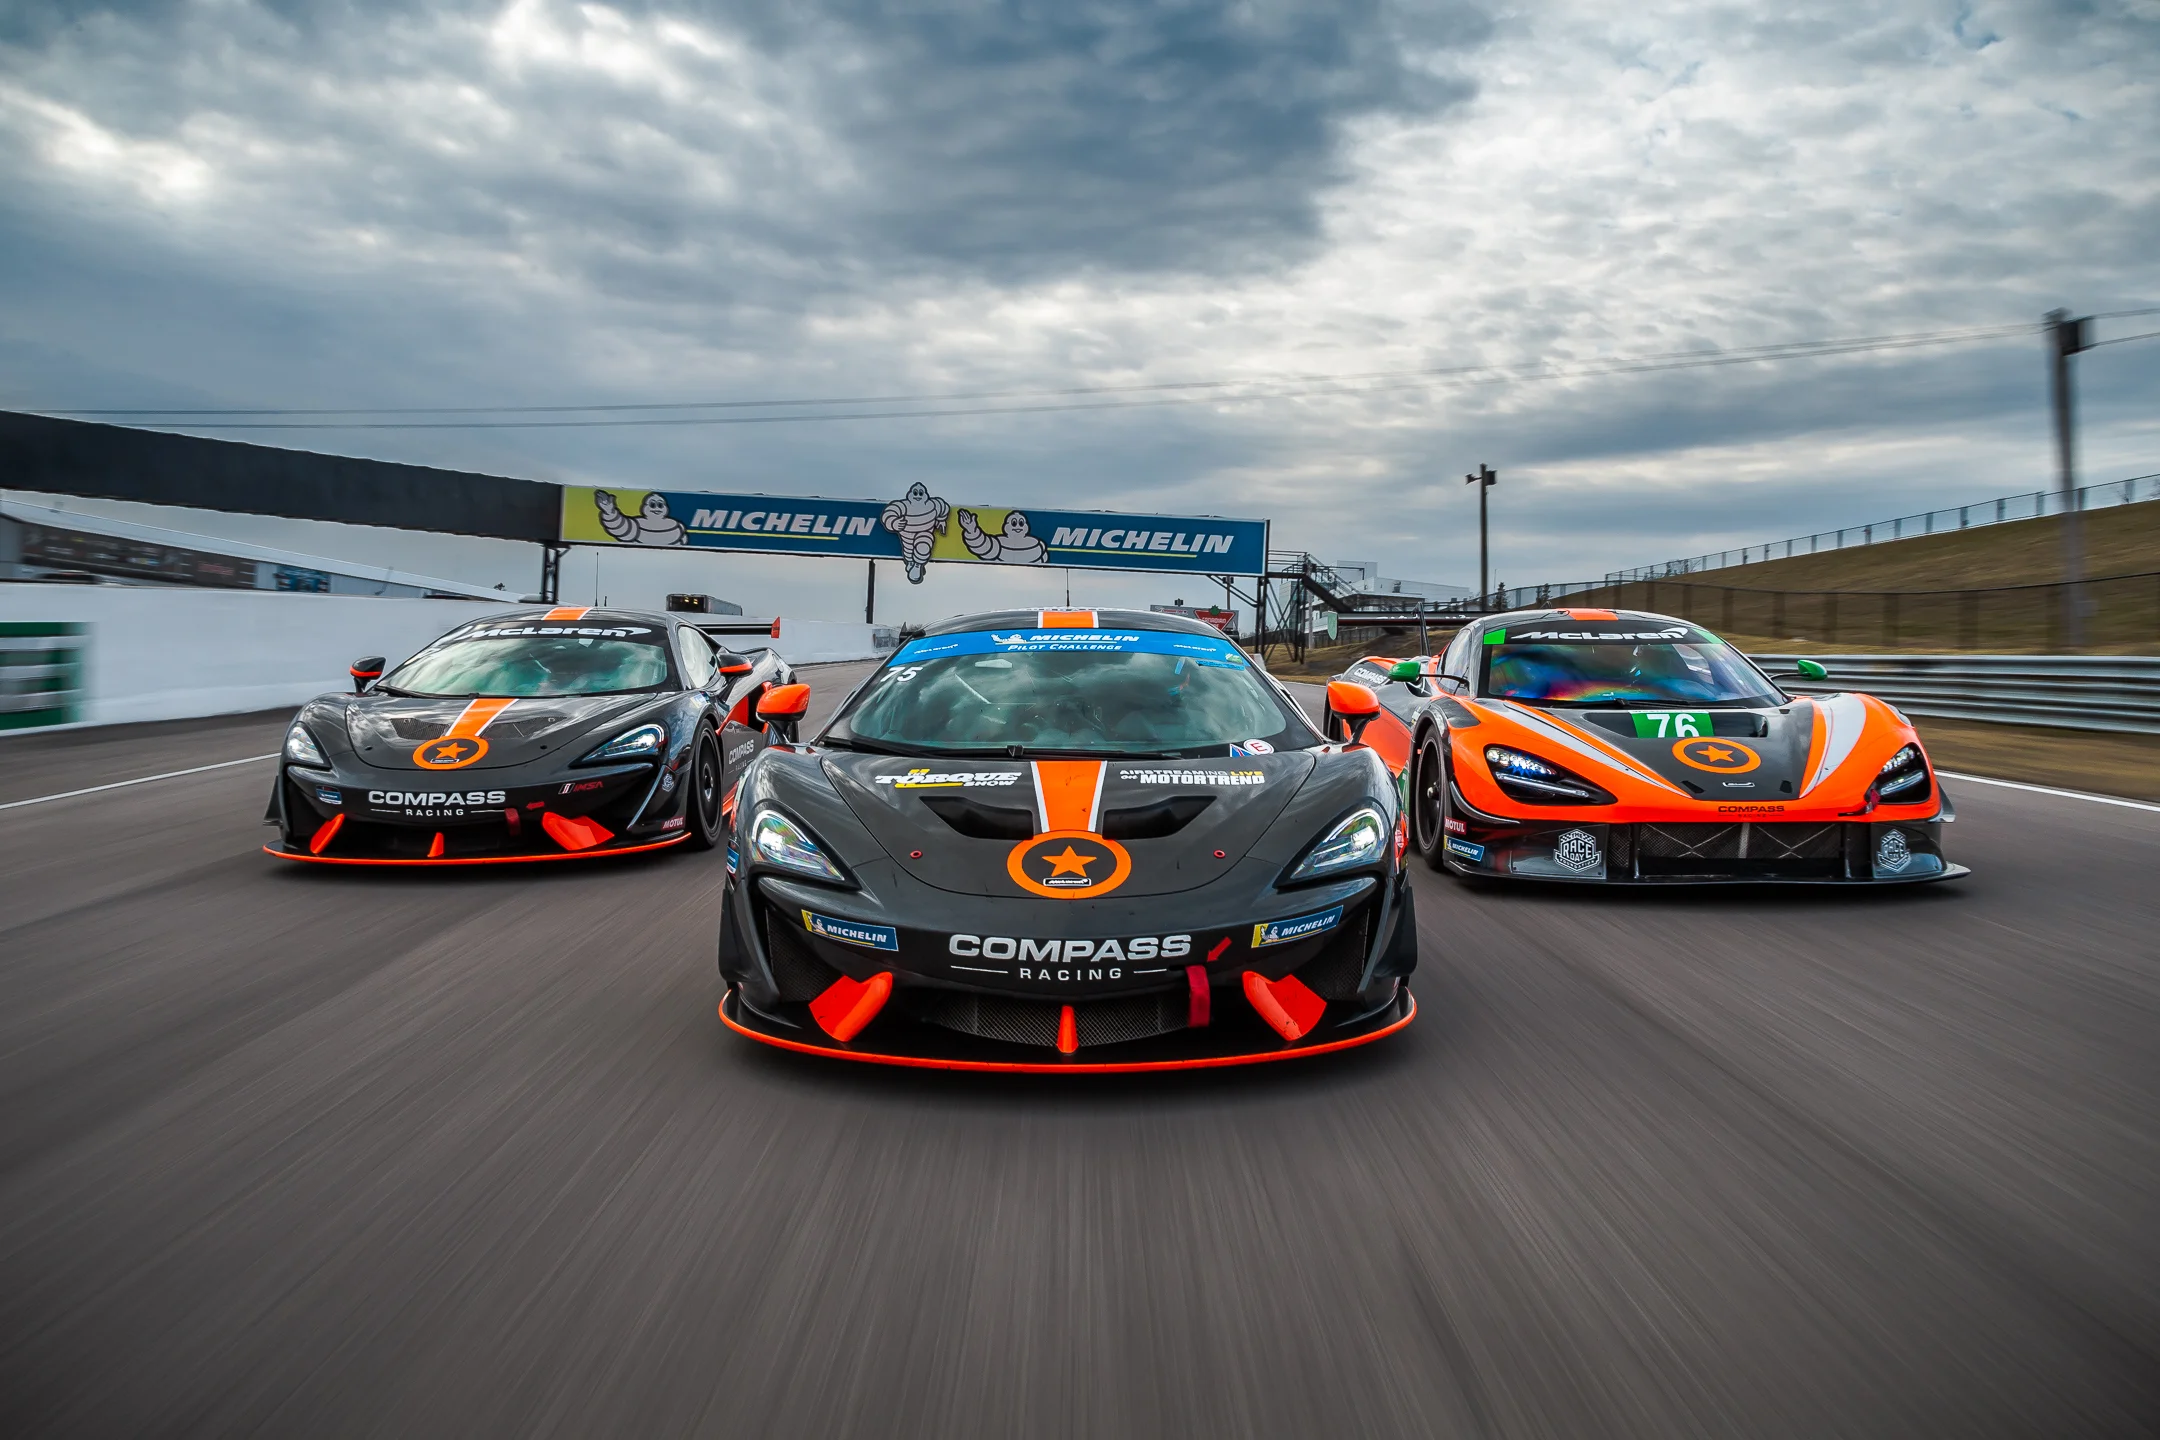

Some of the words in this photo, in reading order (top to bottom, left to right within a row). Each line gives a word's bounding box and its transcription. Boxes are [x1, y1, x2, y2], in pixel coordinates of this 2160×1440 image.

[689, 509, 877, 536] MICHELIN
[1050, 527, 1235, 554] MICHELIN
[1030, 634, 1140, 642] MICHELIN
[1511, 627, 1688, 640] McLaren
[880, 666, 923, 683] 75
[1354, 667, 1388, 684] COMPASS
[1646, 713, 1700, 738] 76
[728, 739, 754, 765] COMPASS
[1250, 742, 1268, 752] E
[875, 771, 1022, 784] TORQUE
[1140, 774, 1266, 786] MOTORTREND
[573, 781, 604, 793] IMSA
[368, 790, 506, 807] COMPASS
[405, 808, 464, 817] RACING
[1717, 805, 1785, 813] COMPASS
[1445, 818, 1465, 833] MOTUL
[1563, 839, 1592, 859] RACE
[1570, 853, 1585, 862] DAY
[827, 924, 887, 943] MICHELIN
[1281, 914, 1336, 937] MICHELIN
[949, 934, 1192, 963] COMPASS
[1019, 967, 1122, 981] RACING
